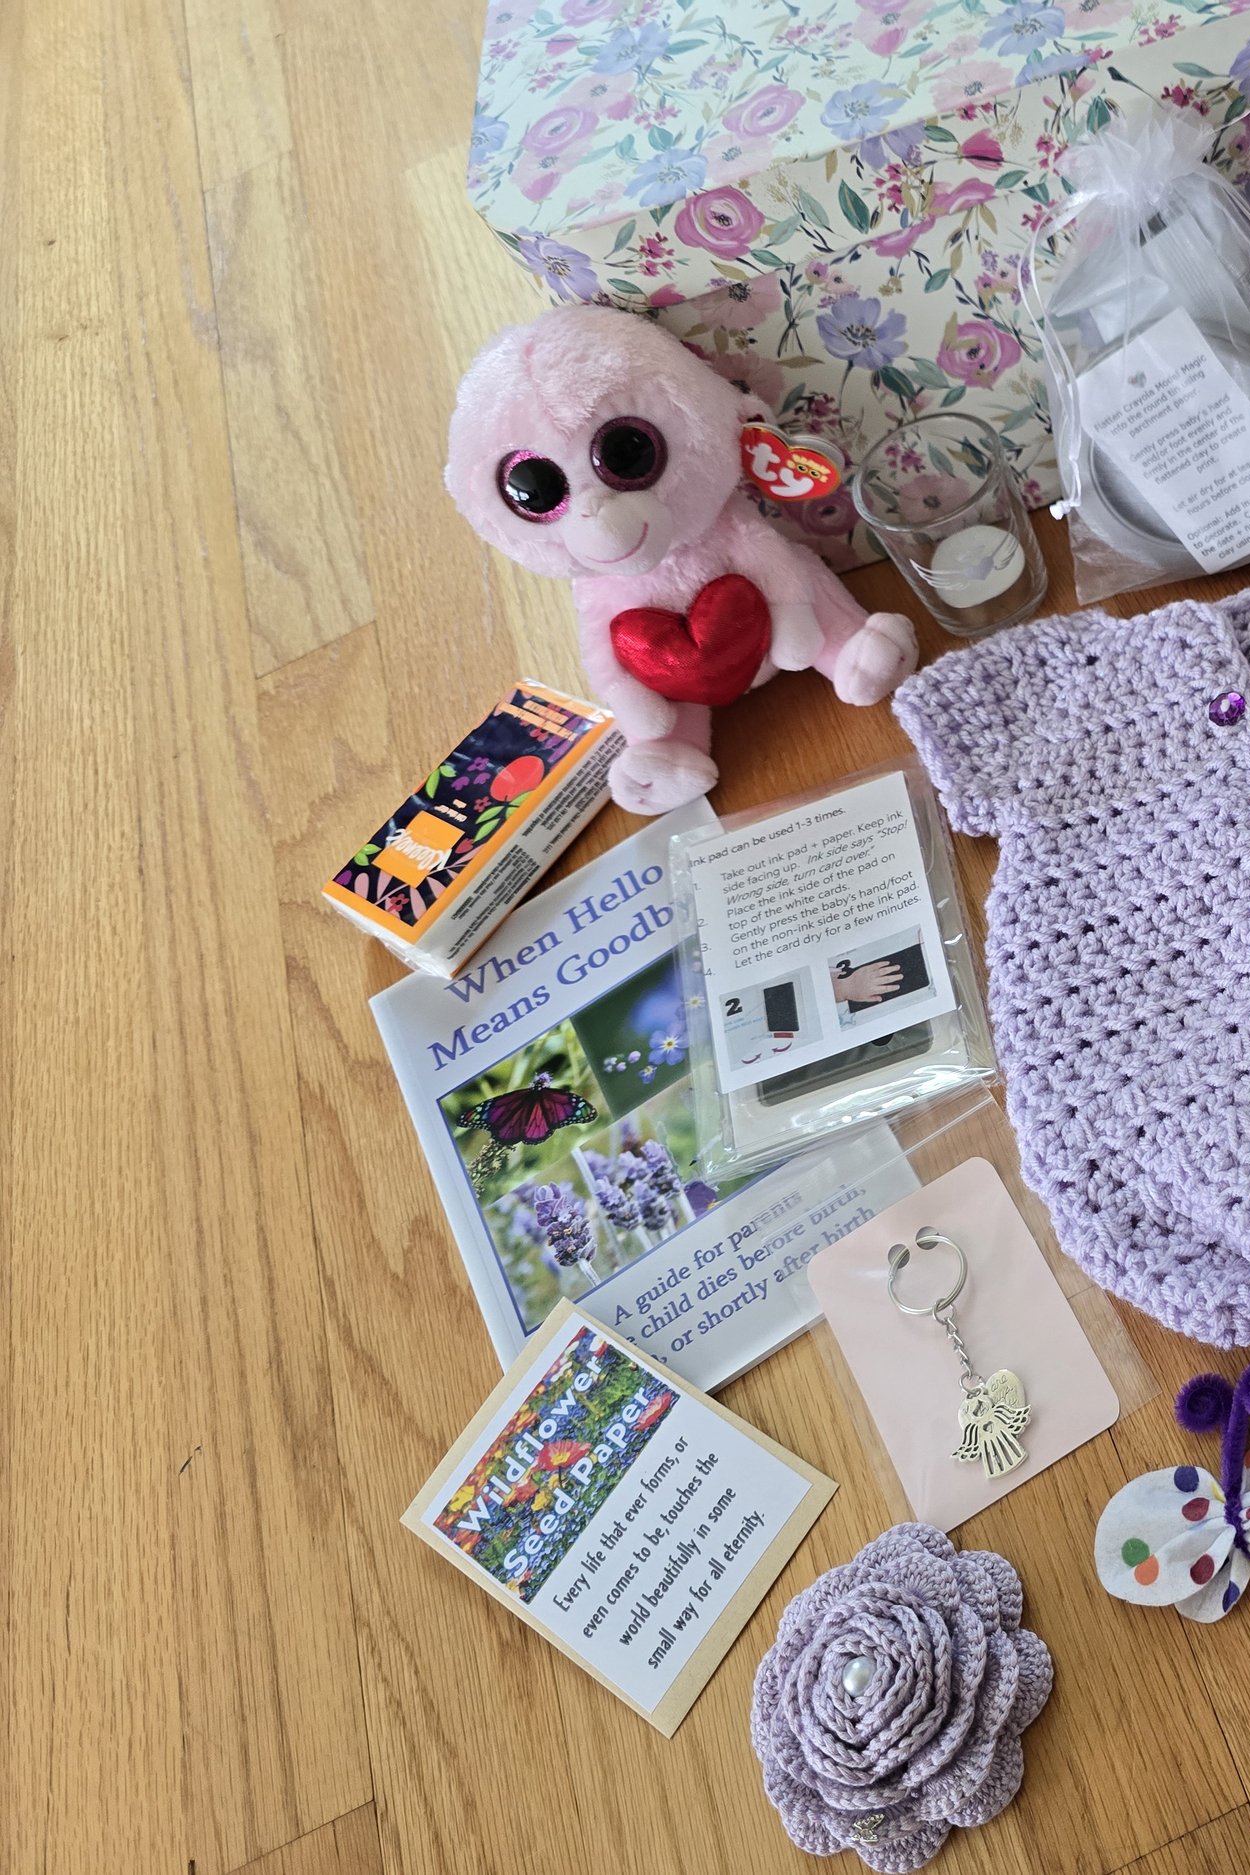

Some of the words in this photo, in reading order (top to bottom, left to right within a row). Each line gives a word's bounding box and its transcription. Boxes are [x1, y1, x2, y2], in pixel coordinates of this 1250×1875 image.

[1122, 389, 1155, 412] Crayola
[1180, 354, 1206, 375] Magic
[1126, 411, 1142, 424] the
[1142, 392, 1168, 414] round
[1128, 404, 1172, 438] parchment
[1156, 427, 1179, 446] press
[1207, 392, 1230, 412] hand
[1168, 435, 1186, 449] foot
[1215, 405, 1232, 421] and
[1192, 428, 1217, 448] center
[1219, 420, 1228, 431] of
[1208, 442, 1219, 451] to
[744, 442, 815, 498] ty
[1199, 483, 1213, 496] dry
[1213, 475, 1226, 487] for
[1227, 469, 1237, 479] at
[1209, 482, 1237, 501] before
[1224, 504, 1241, 518] Add
[1240, 500, 1250, 508] in
[1192, 540, 1203, 549] to
[1200, 545, 1216, 556] the
[708, 846, 728, 863] pad
[730, 841, 750, 853] can
[751, 836, 766, 845] be
[768, 823, 793, 839] used
[795, 817, 812, 829] 1-3
[814, 807, 845, 822] times.
[720, 868, 744, 880] Take
[746, 859, 766, 872] out
[768, 852, 784, 864] ink
[787, 843, 807, 860] pad
[821, 829, 855, 848] paper.
[857, 818, 884, 832] Keep
[886, 810, 903, 822] ink
[722, 880, 745, 894] side
[746, 868, 780, 885] facing
[782, 862, 800, 872] up.
[807, 851, 824, 864] Ink
[825, 843, 848, 857] side
[850, 834, 873, 849] says
[726, 887, 763, 905] Wrong
[765, 877, 789, 892] side,
[793, 868, 815, 881] turn
[818, 855, 843, 872] card
[726, 903, 755, 918] Place
[757, 895, 775, 907] the
[778, 887, 795, 899] ink
[797, 879, 820, 893] side
[822, 872, 833, 884] of
[836, 868, 854, 879] the
[857, 857, 878, 874] pad
[880, 852, 895, 863] on
[728, 919, 747, 930] top
[750, 910, 761, 922] of
[764, 906, 782, 917] the
[784, 895, 815, 910] white
[817, 883, 850, 899] cards.
[730, 925, 766, 942] Gently
[768, 913, 797, 932] press
[799, 907, 818, 918] the
[821, 893, 856, 911] baby's
[858, 870, 912, 898] hand/foot
[443, 931, 562, 1002] When
[563, 865, 663, 934] Hello
[732, 945, 748, 955] on
[749, 938, 768, 949] the
[771, 920, 815, 942] non-ink
[817, 912, 840, 926] side
[842, 905, 854, 917] of
[856, 900, 874, 912] the
[877, 891, 894, 904] ink
[896, 880, 919, 899] pad.
[734, 956, 752, 968] Let
[754, 950, 773, 961] the
[776, 937, 800, 953] card
[802, 932, 822, 944] dry
[824, 925, 841, 936] for
[844, 922, 851, 930] a
[853, 914, 873, 926] few
[876, 895, 921, 918] minutes.
[426, 985, 550, 1071] Means
[556, 901, 673, 984] Goodb
[835, 959, 852, 980] 3
[725, 997, 744, 1017] 2
[614, 1304, 632, 1326] A
[635, 1266, 691, 1314] guide
[693, 1241, 724, 1270] for
[640, 1292, 694, 1338] child
[696, 1267, 737, 1300] dies
[670, 1329, 693, 1351] or
[697, 1278, 767, 1334] shortly
[773, 1243, 819, 1282] after
[820, 1206, 876, 1246] birth
[457, 1356, 603, 1533] Wildflower
[503, 1489, 576, 1577] Seed
[570, 1387, 651, 1487] Paper
[552, 1573, 590, 1612] Every
[580, 1550, 606, 1574] life
[599, 1520, 627, 1550] that
[624, 1492, 647, 1522] ever
[640, 1455, 679, 1493] forms,
[674, 1436, 688, 1452] or
[582, 1605, 608, 1638] even
[606, 1563, 639, 1604] comes
[632, 1546, 650, 1562] to
[642, 1527, 669, 1545] be,
[659, 1475, 702, 1524] touches
[695, 1453, 718, 1475] the
[619, 1601, 650, 1645] world
[641, 1538, 701, 1607] beautifully
[696, 1523, 710, 1539] in
[707, 1487, 736, 1523] some
[647, 1626, 676, 1669] small
[672, 1601, 699, 1631] way
[688, 1579, 712, 1602] for
[708, 1557, 726, 1580] all
[723, 1510, 764, 1561] eternity.
